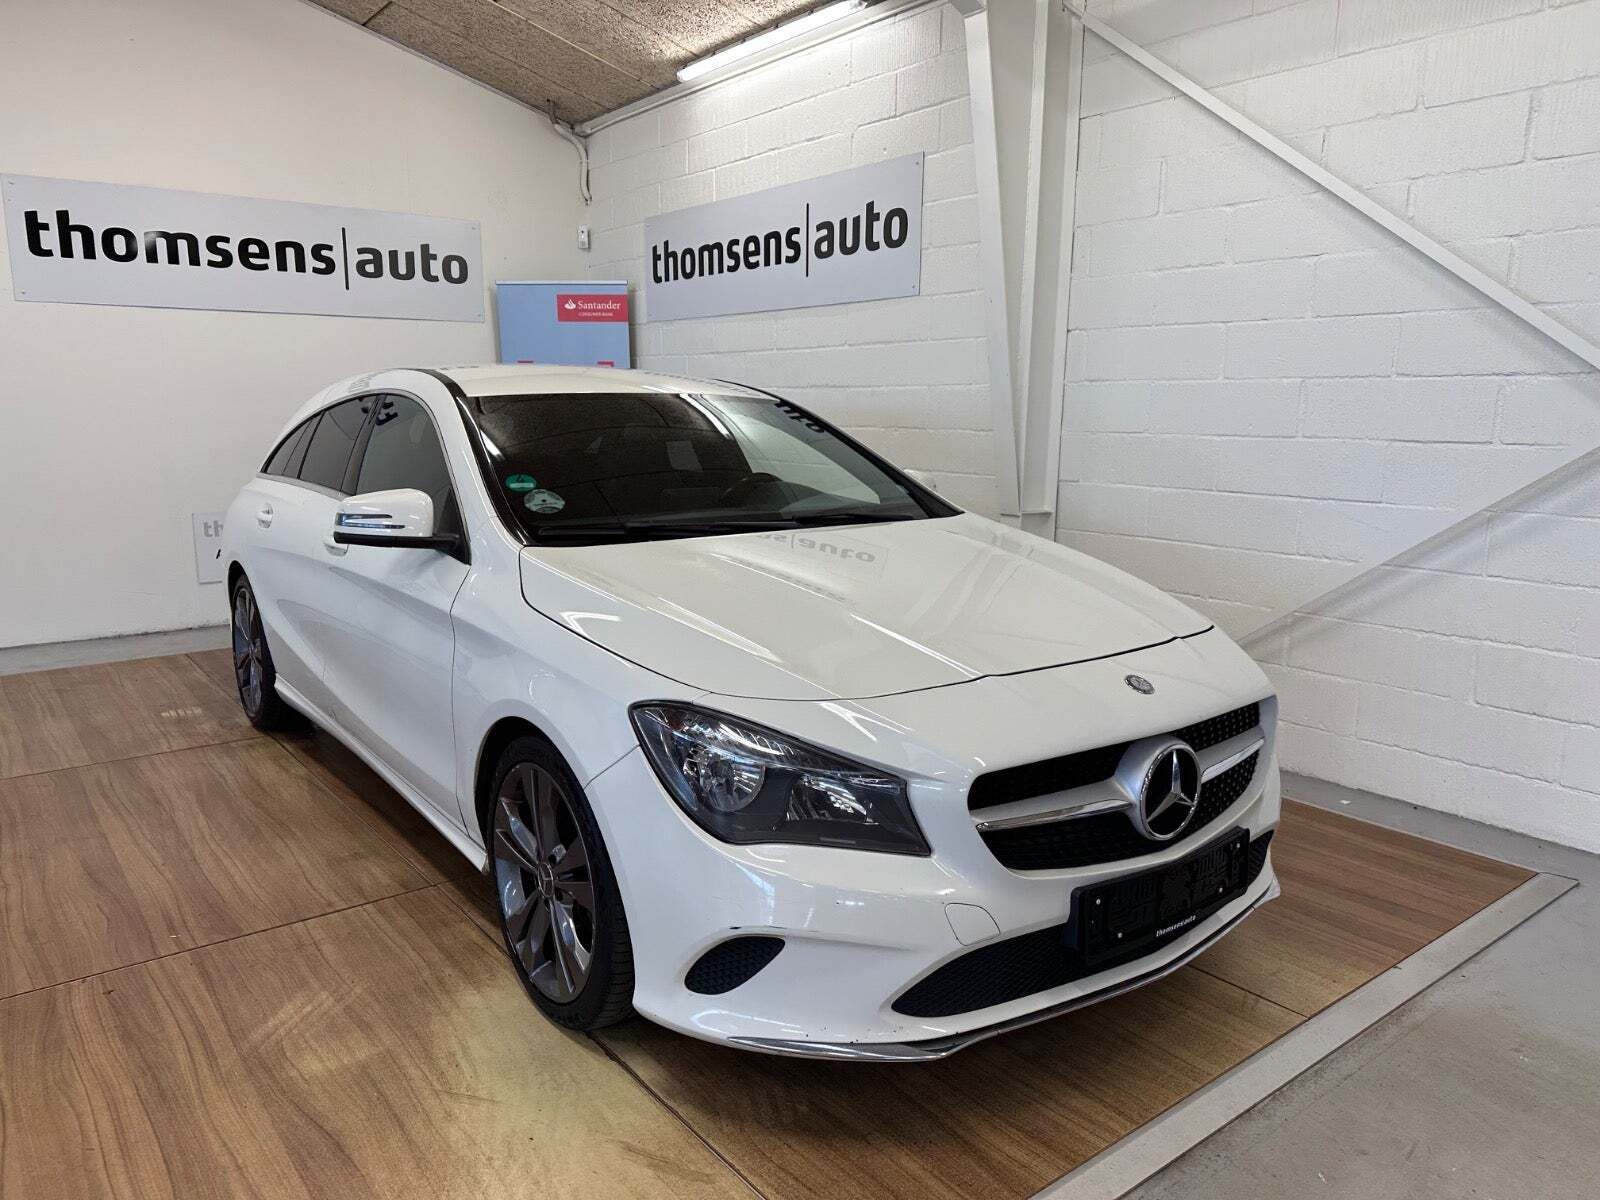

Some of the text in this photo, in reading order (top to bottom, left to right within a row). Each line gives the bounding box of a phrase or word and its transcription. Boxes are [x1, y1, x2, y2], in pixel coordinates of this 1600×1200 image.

[24, 209, 469, 285] thomsens auto
[651, 199, 909, 284] thomsens auto
[577, 299, 622, 310] Santander
